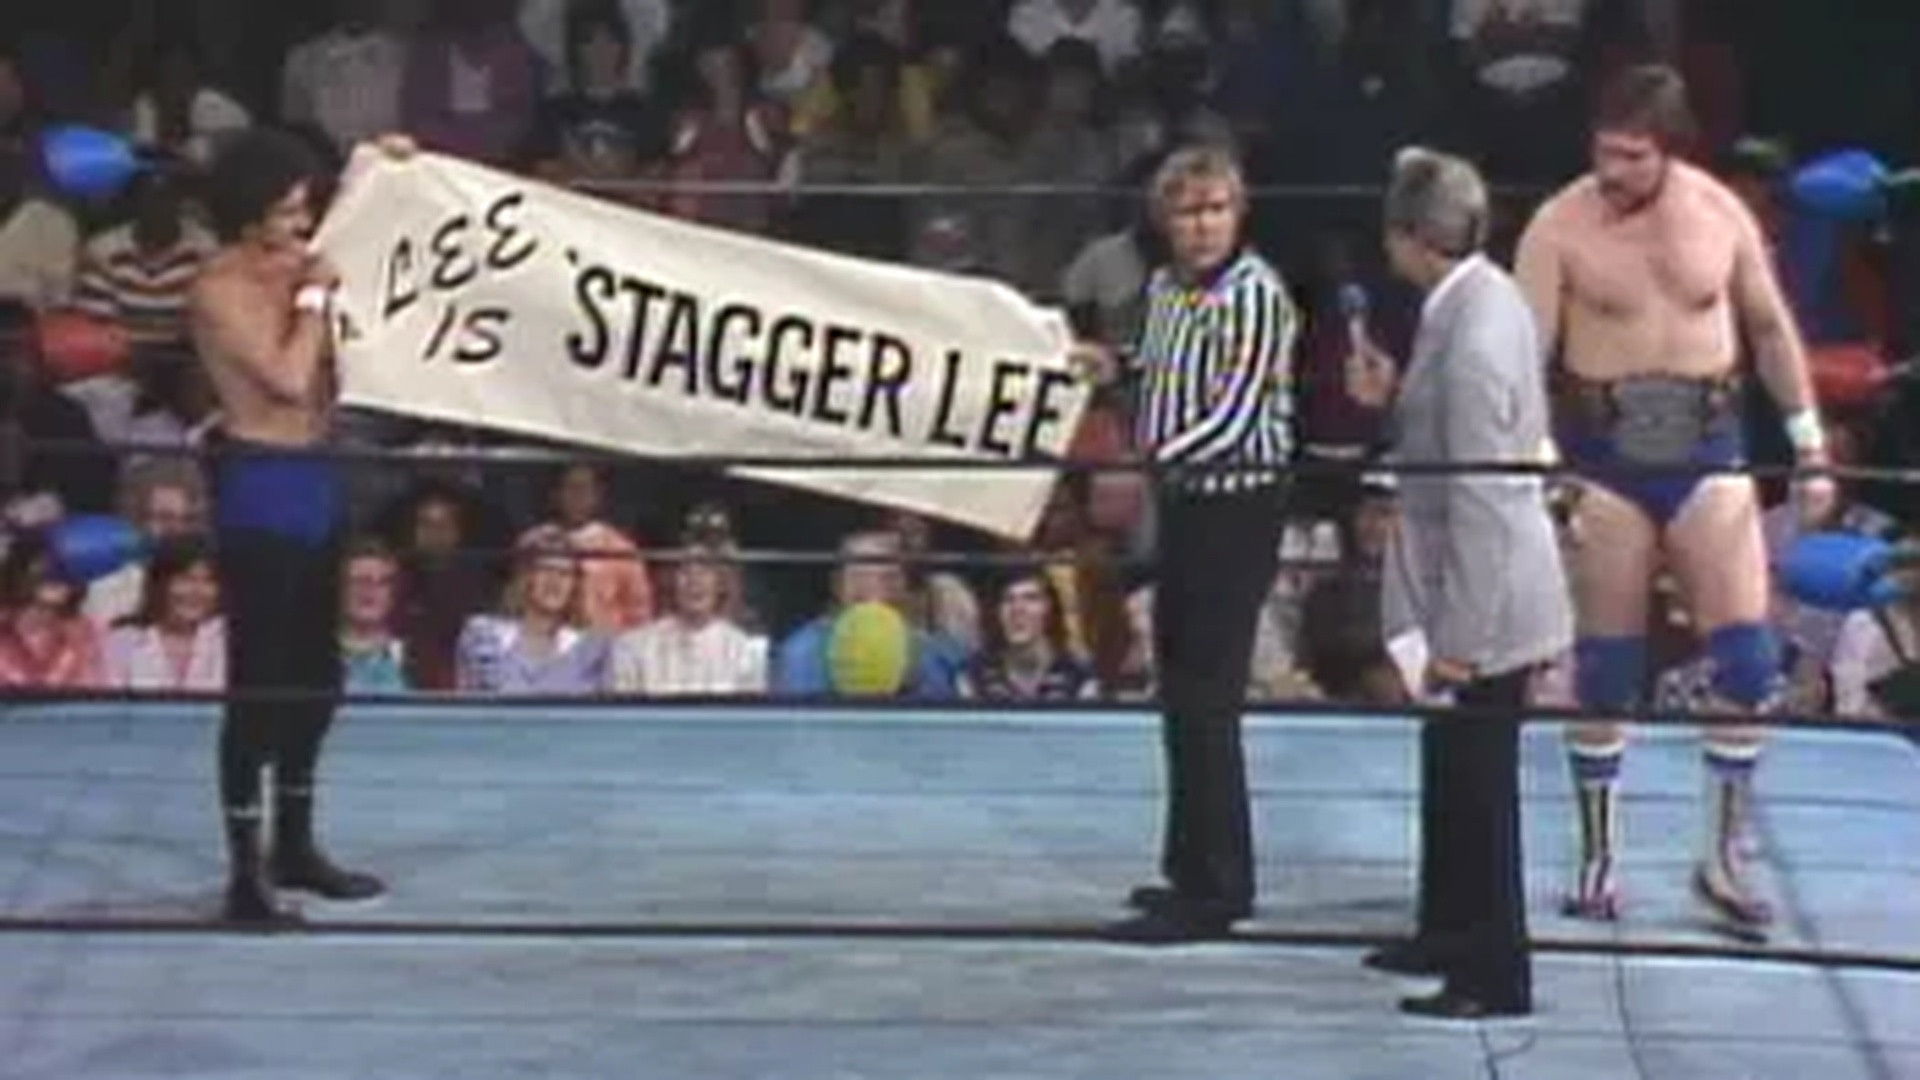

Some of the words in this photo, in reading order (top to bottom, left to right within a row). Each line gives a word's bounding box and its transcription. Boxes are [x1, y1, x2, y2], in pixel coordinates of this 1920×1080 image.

[383, 193, 538, 319] LEE
[424, 305, 508, 363] IS
[928, 350, 1074, 458] LEE
